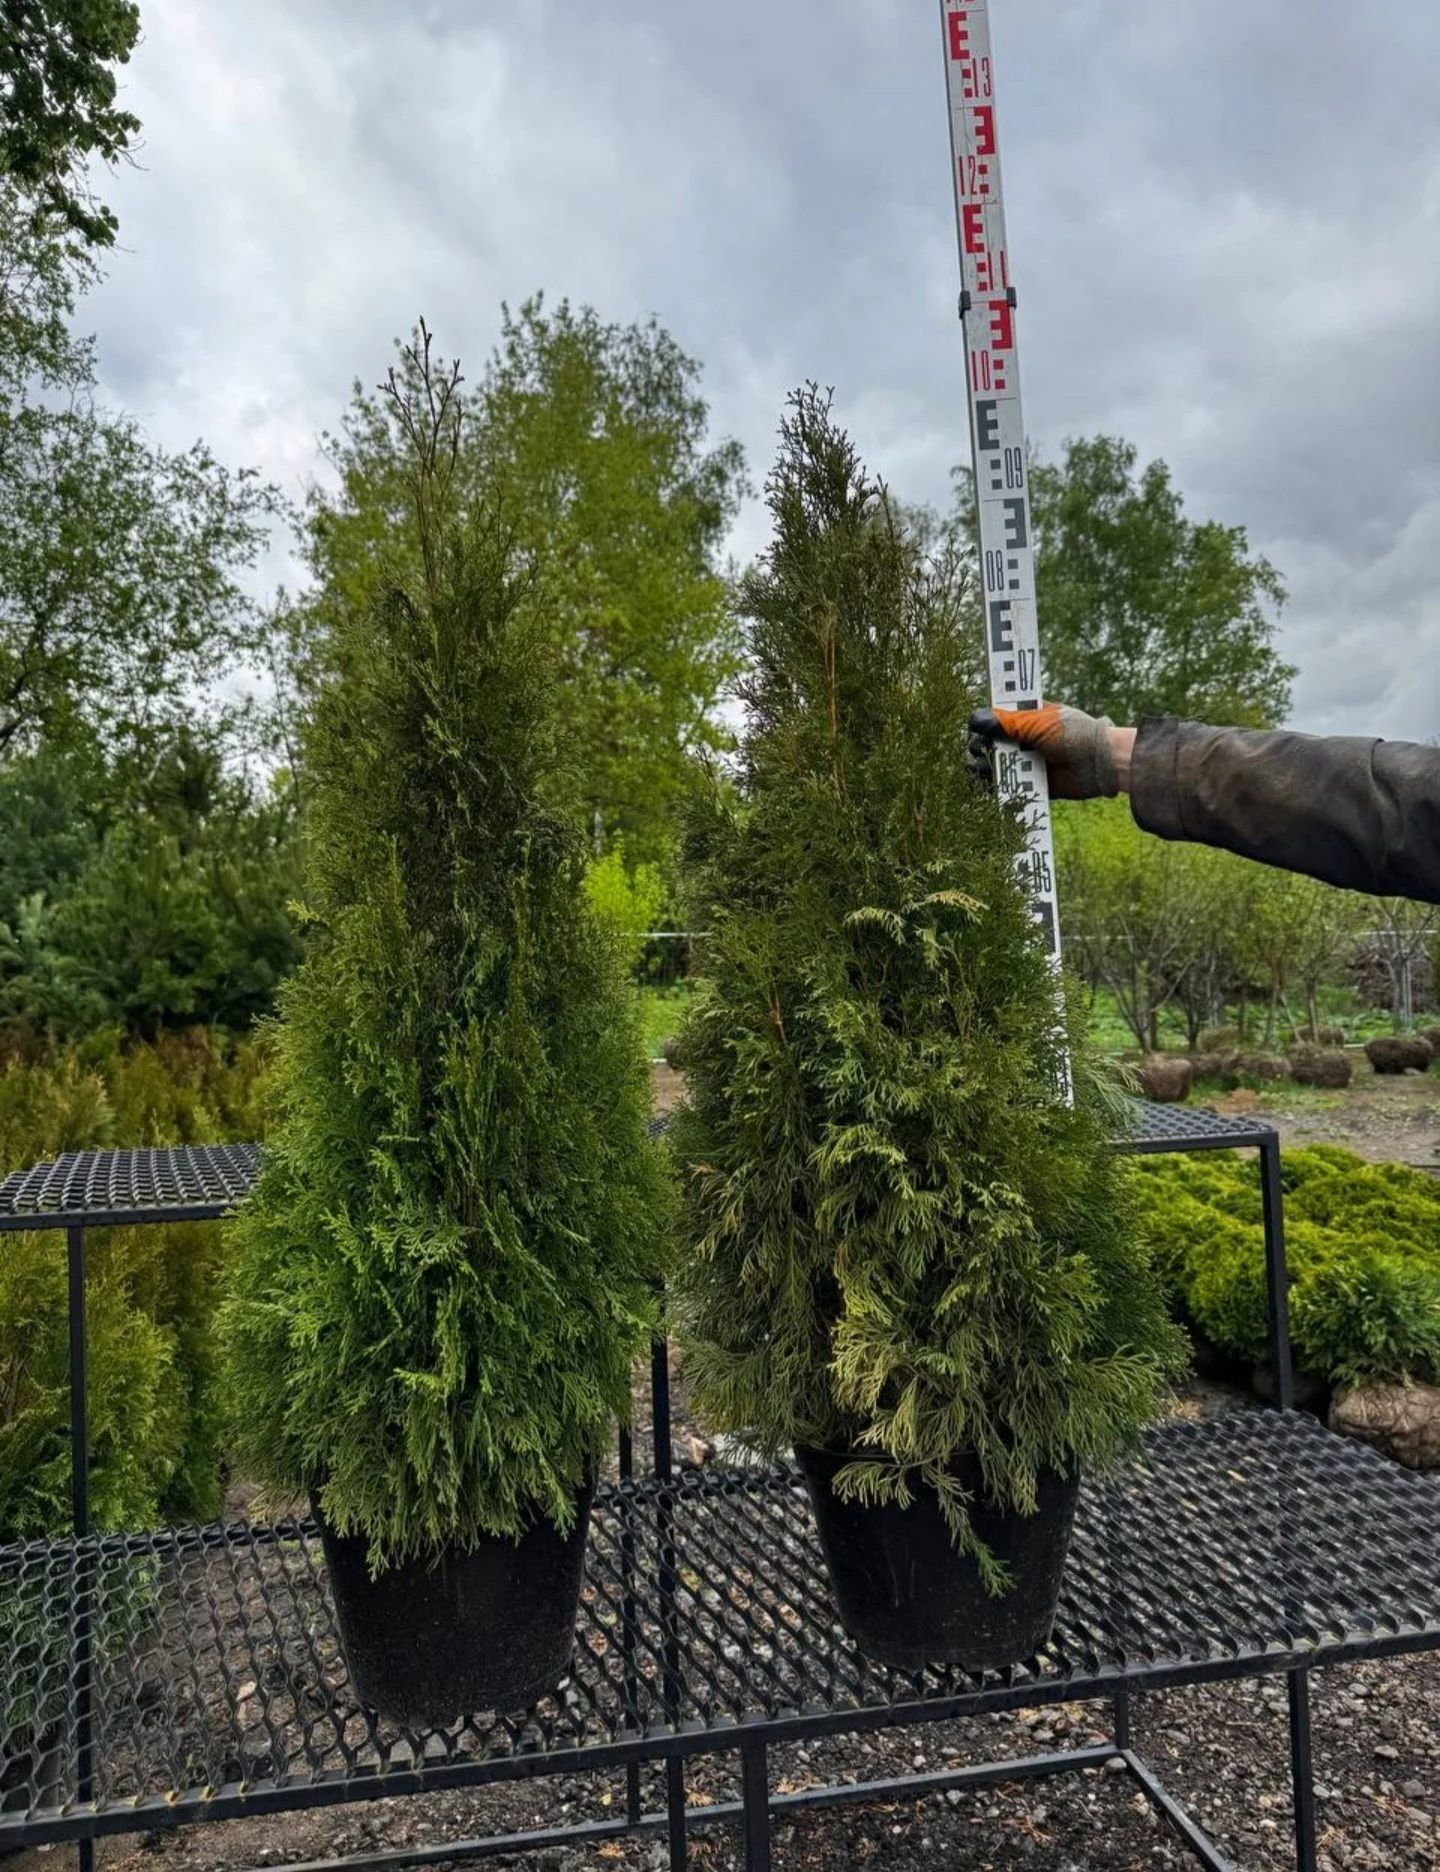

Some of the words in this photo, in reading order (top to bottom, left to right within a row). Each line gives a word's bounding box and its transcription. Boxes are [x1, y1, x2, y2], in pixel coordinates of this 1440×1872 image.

[972, 57, 991, 98] 13
[958, 155, 978, 196] 12
[987, 250, 1007, 291] 11
[971, 350, 991, 392] 10
[1005, 447, 1023, 489] 09
[986, 550, 1004, 592] 08
[1018, 648, 1034, 691] 07
